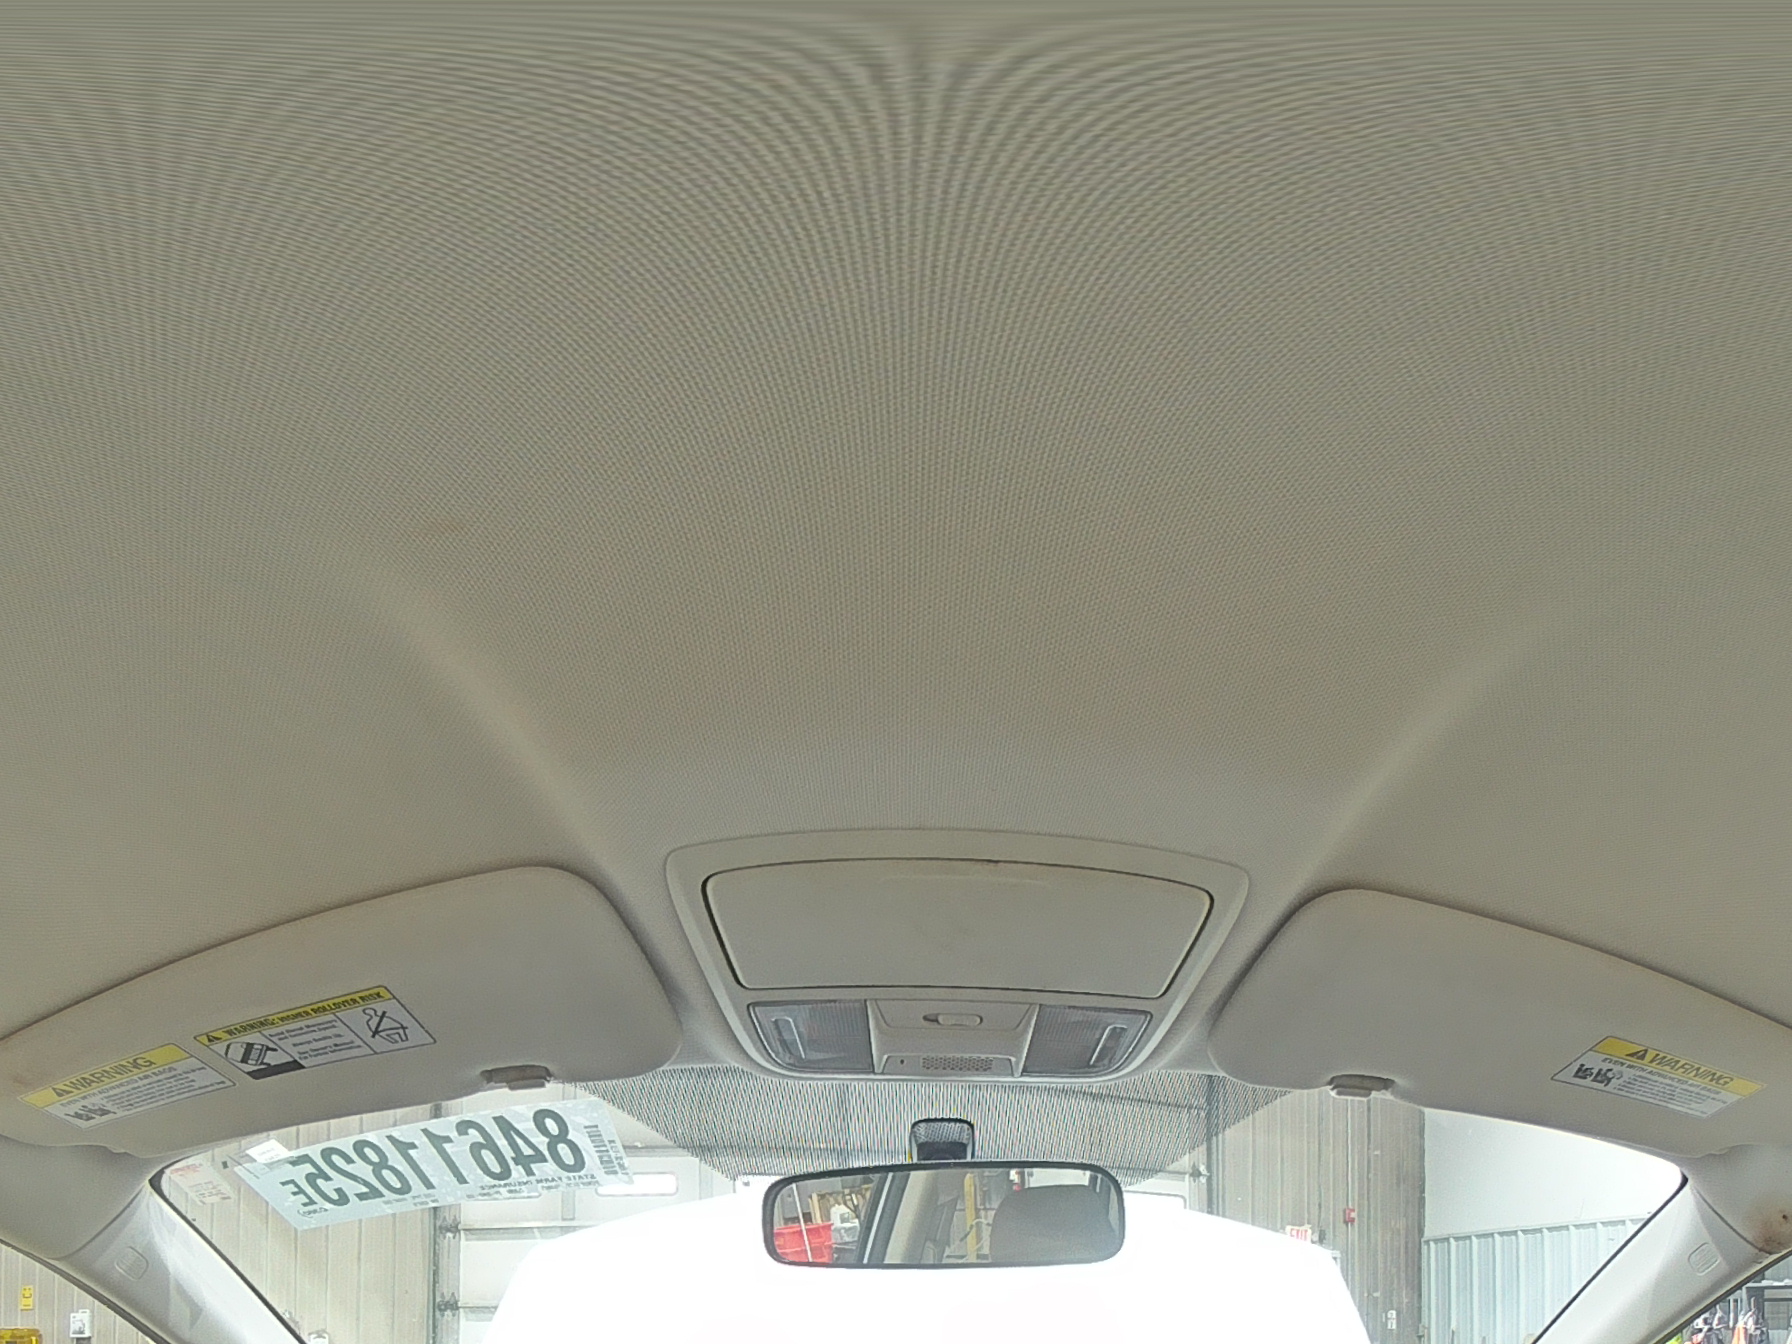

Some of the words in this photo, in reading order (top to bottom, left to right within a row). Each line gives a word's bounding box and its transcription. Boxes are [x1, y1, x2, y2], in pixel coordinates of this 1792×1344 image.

[311, 997, 358, 1016] ROLLOVER
[359, 990, 385, 1006] RISK
[65, 1055, 157, 1092] WARNING
[1601, 1056, 1626, 1068] EVEN
[1626, 1063, 1647, 1075] WITH
[1649, 1052, 1734, 1087] WARNING
[1289, 1227, 1309, 1242] EXIT
